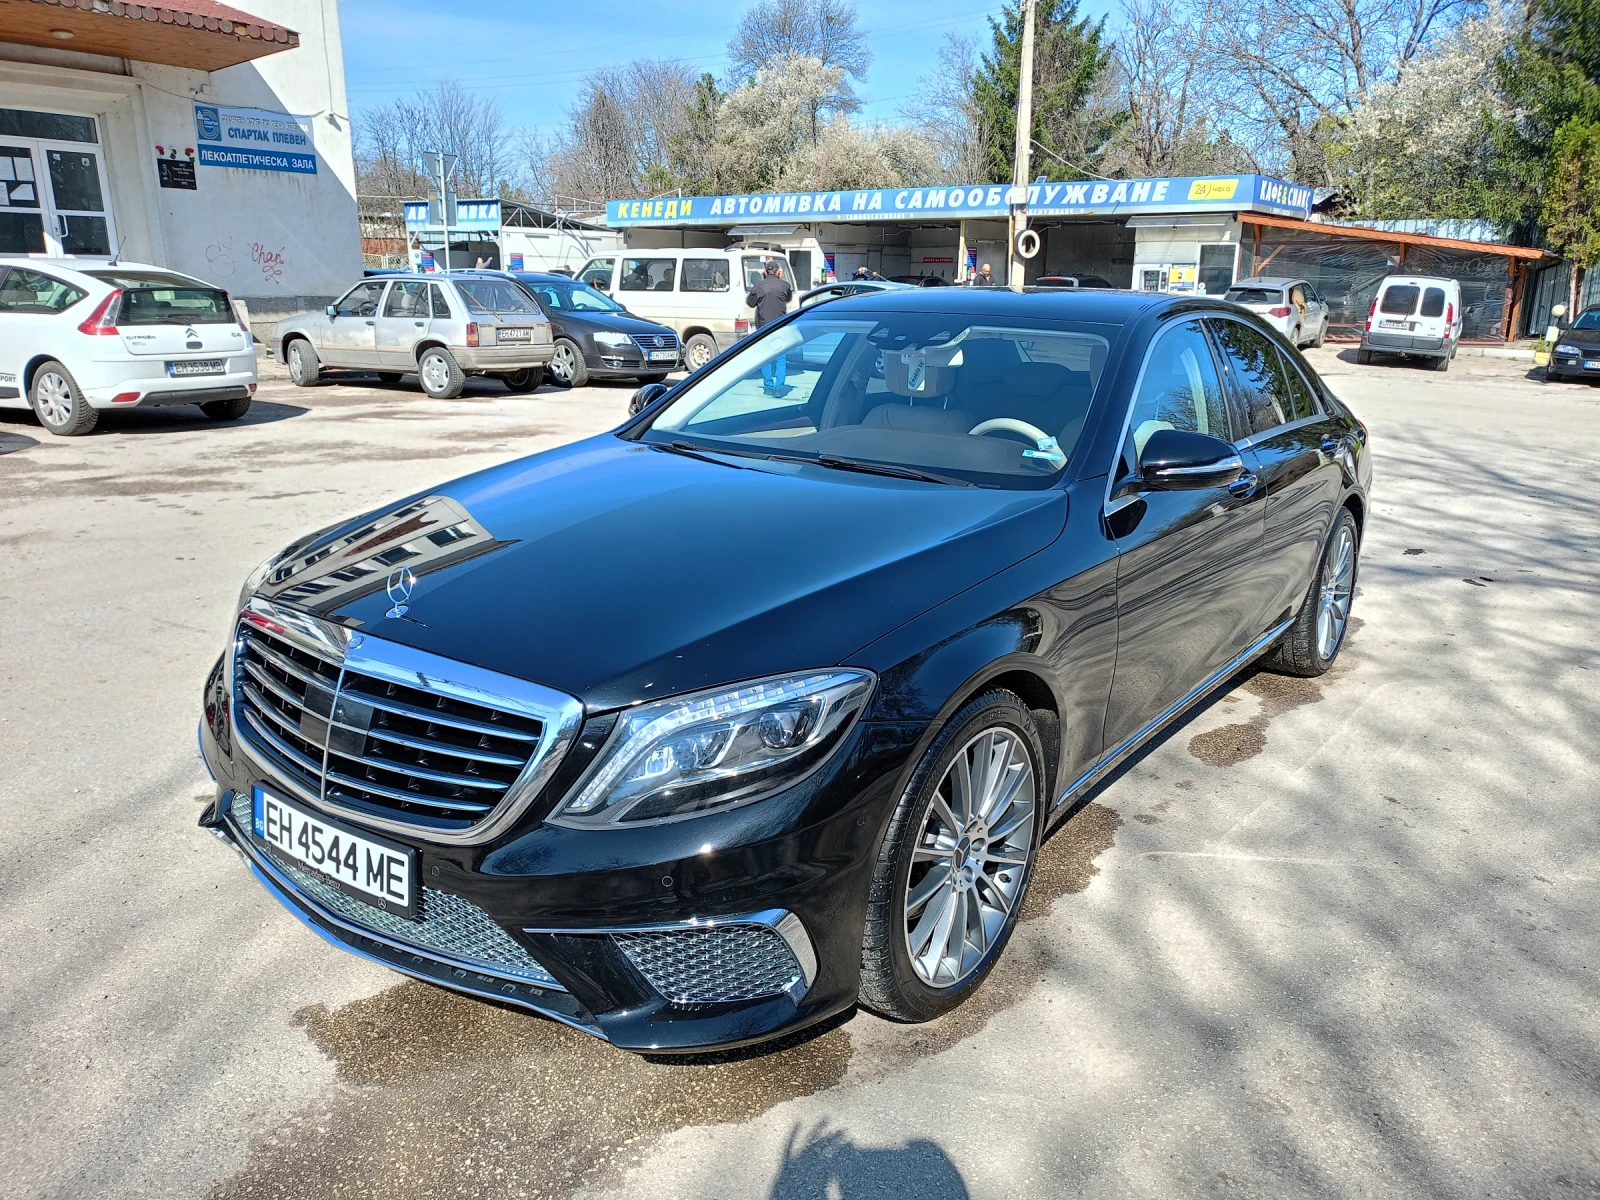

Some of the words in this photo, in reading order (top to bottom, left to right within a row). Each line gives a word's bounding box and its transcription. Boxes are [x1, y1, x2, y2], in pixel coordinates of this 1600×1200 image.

[227, 126, 270, 143] СПАРТАК
[272, 132, 307, 146] ПЛЕВЕН
[201, 150, 289, 168] ЛЕКОАТЛЕТИЧЕСКА
[291, 158, 315, 170] ЗАЛА
[407, 203, 498, 220] АВИВКА
[617, 199, 693, 219] КЕНЕДИ
[710, 193, 841, 215] АВТОМИВКА
[852, 192, 883, 211] НА
[255, 819, 264, 832] BG
[266, 800, 293, 850] EH
[297, 821, 359, 882] 4544
[366, 847, 405, 901] ME
[297, 860, 342, 891] Mercedes-Benz
